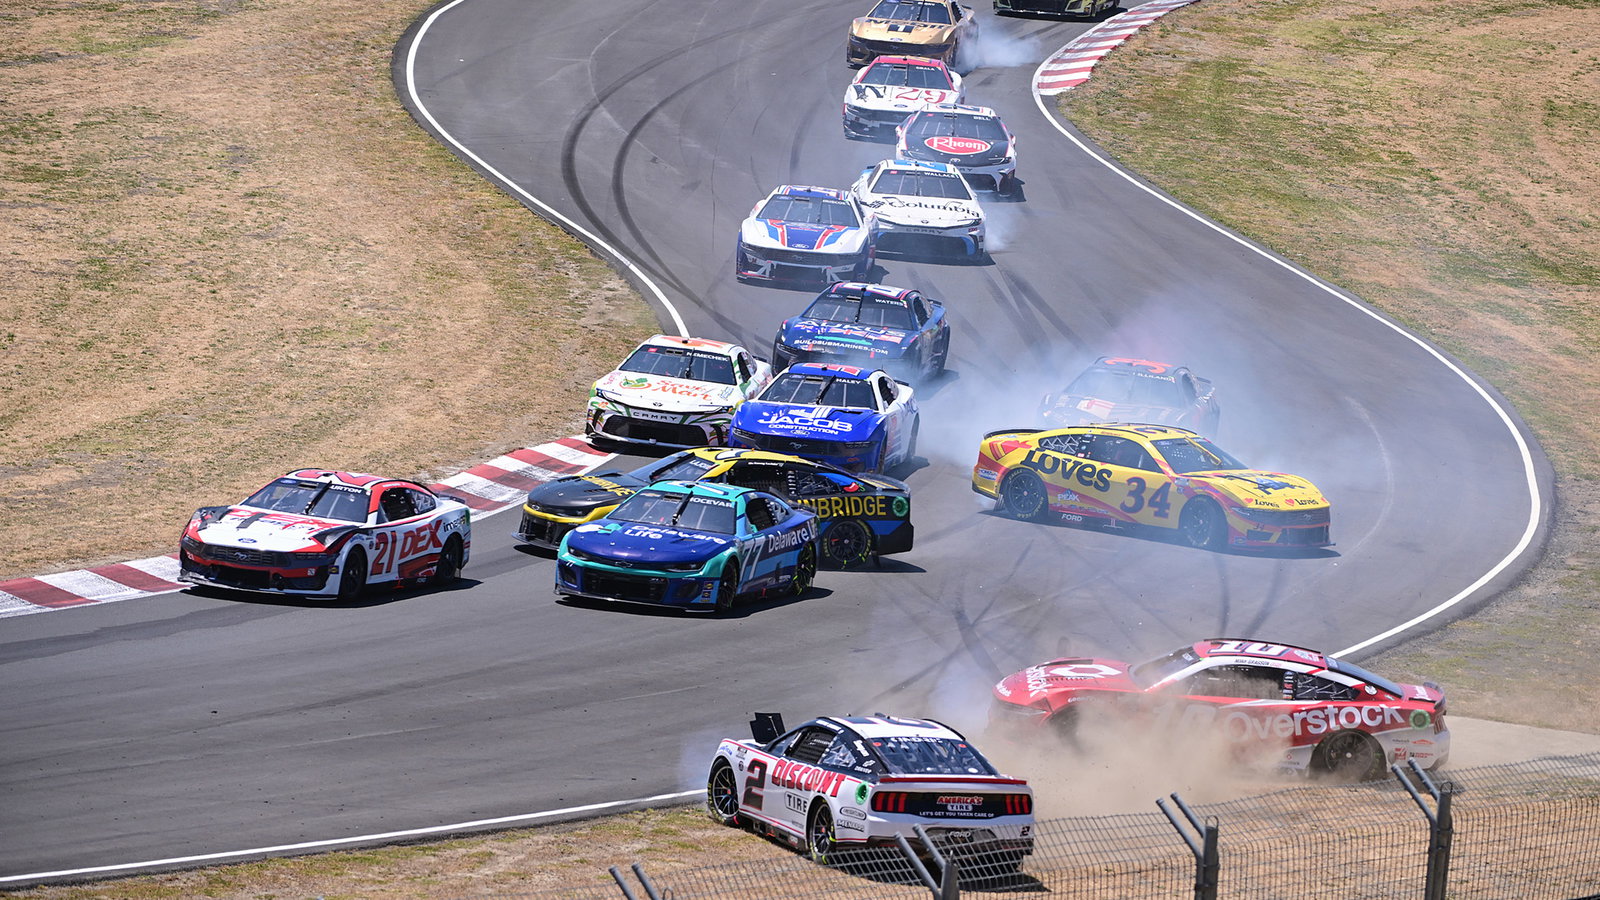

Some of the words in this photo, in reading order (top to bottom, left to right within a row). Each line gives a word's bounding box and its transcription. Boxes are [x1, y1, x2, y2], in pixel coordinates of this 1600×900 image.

[932, 137, 986, 151] Rheem
[888, 201, 980, 218] Columbia
[794, 339, 889, 355] BUILDSUBMARINES.COM
[652, 385, 712, 401] Mart
[633, 411, 679, 421] CAMRY
[758, 415, 853, 433] JACOB
[768, 424, 839, 435] CONSTRUCTION
[329, 484, 362, 494] URTON
[1057, 493, 1080, 502] PEAK
[1119, 476, 1172, 519] 34
[1061, 513, 1083, 522] FORD
[398, 519, 443, 561] DEX
[623, 529, 664, 539] Life
[631, 525, 727, 545] Delaware
[768, 526, 810, 553] Delaware
[370, 530, 397, 577] 21
[739, 535, 766, 582] 77
[1222, 703, 1405, 743] Overstock
[742, 757, 768, 811] 2
[771, 759, 847, 798] DISCOUNT
[786, 793, 808, 813] TIRE
[936, 796, 984, 805] AMERICA'S
[1020, 825, 1030, 837] 2
